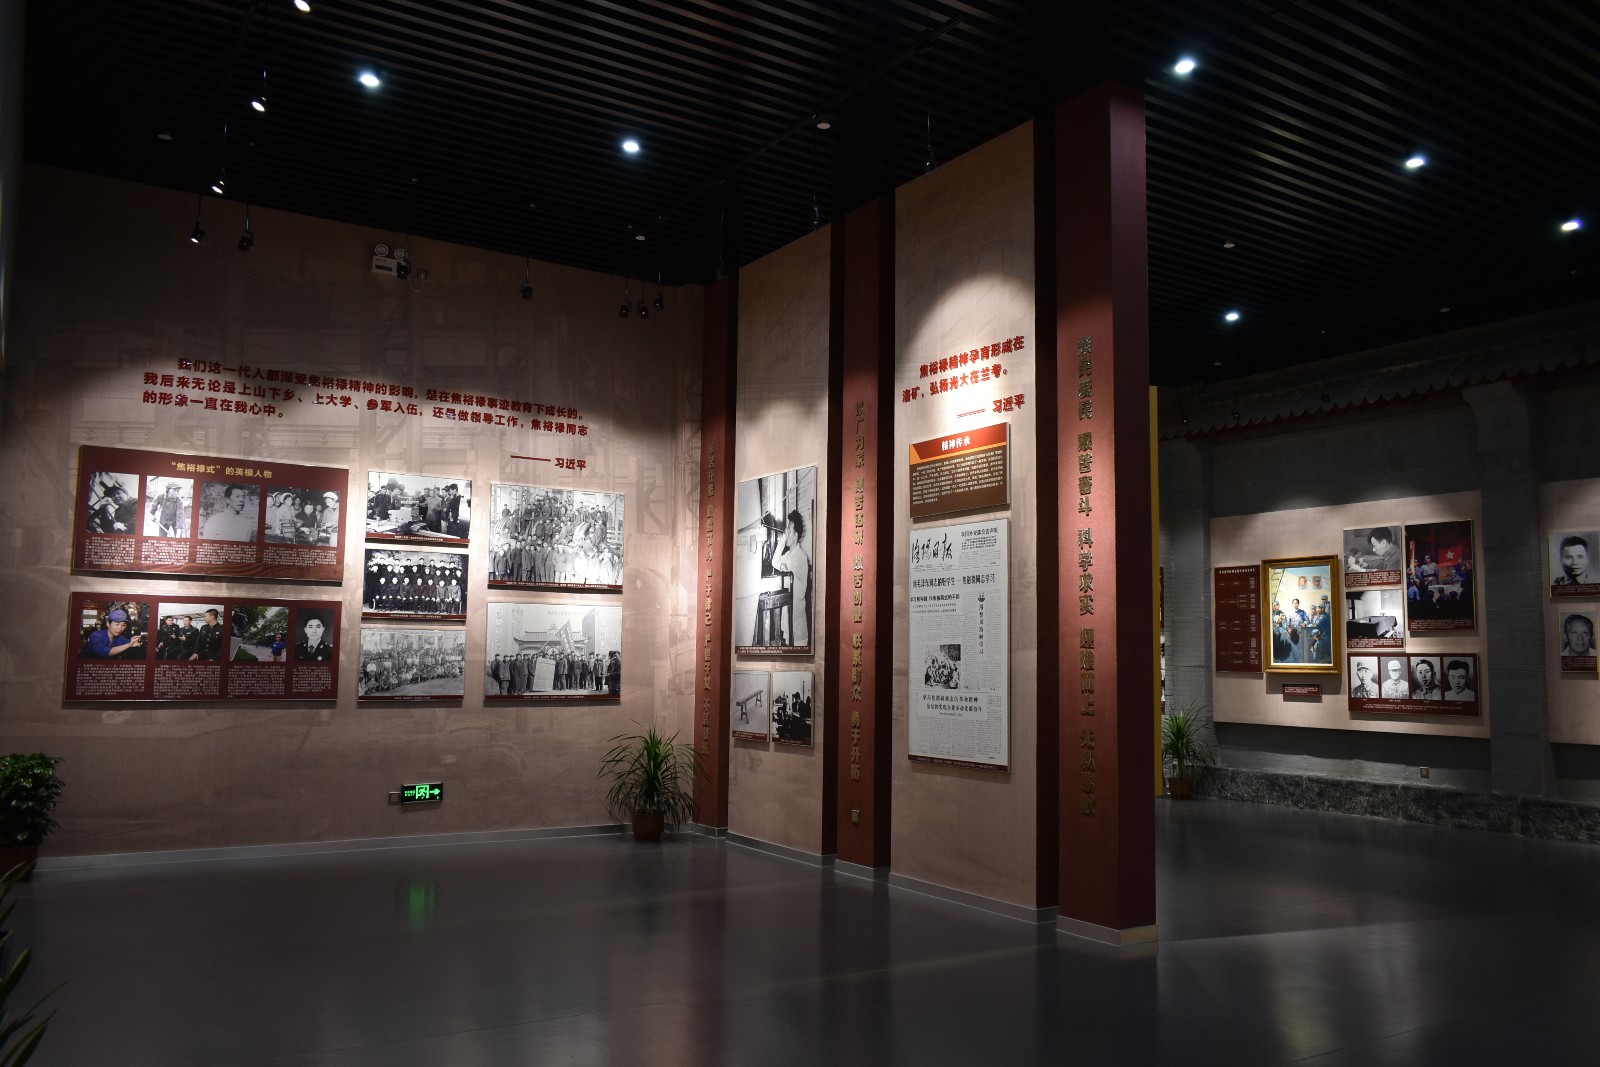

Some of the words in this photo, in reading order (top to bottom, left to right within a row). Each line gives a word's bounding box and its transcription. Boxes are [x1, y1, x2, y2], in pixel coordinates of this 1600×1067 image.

[919, 336, 1025, 379] 焦裕禄精神孕育形成在
[1077, 335, 1092, 420] 亲民爱民
[142, 389, 284, 418] 的形象一直在我心中。
[941, 435, 971, 451] 精神传承
[1077, 432, 1092, 517] 艰苦奋斗
[1078, 528, 1093, 616] 科学求实
[852, 632, 863, 704] 联系群众
[1080, 628, 1095, 717] 迎难而上
[1080, 727, 1096, 818] 无私奉献
